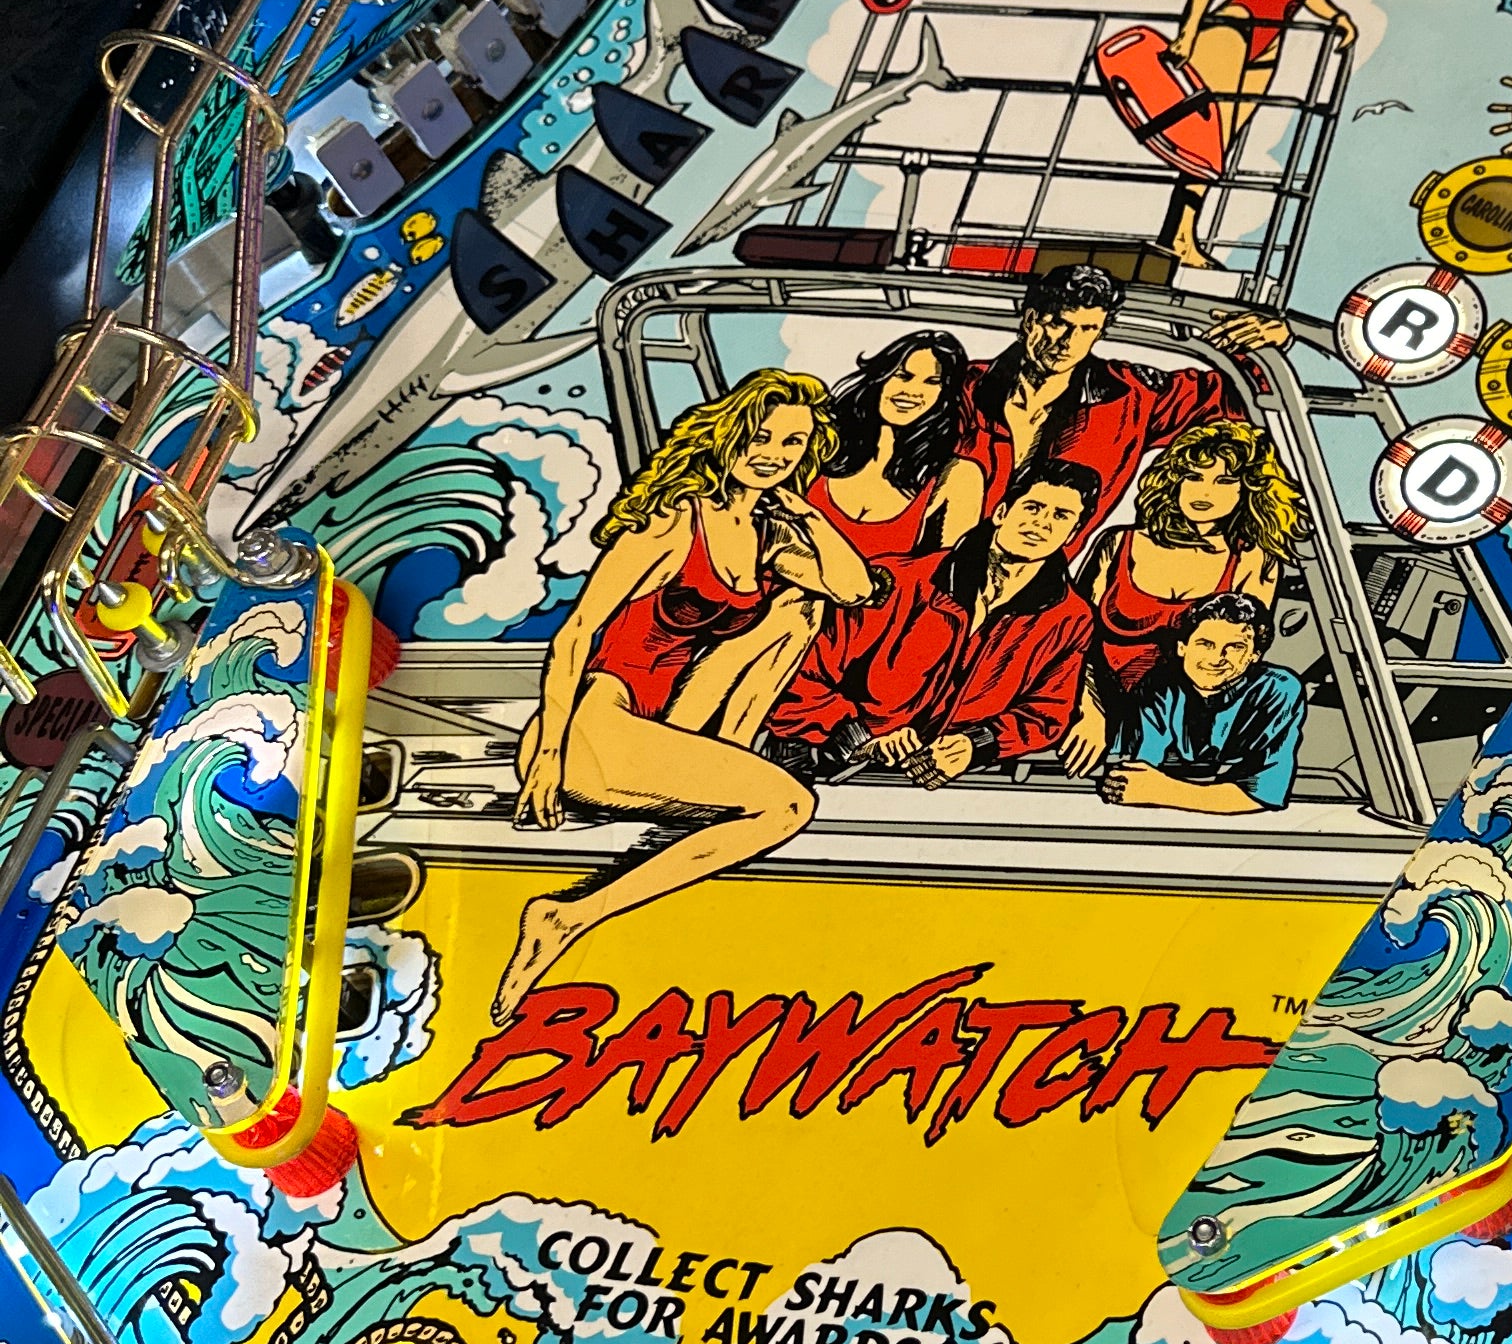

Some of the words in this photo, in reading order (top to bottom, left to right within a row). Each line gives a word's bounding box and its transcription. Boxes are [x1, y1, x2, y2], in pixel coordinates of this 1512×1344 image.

[1379, 298, 1440, 351] R
[1417, 454, 1480, 506] D
[397, 961, 1282, 1147] BAYWATCH
[538, 1228, 772, 1303] COLLECT
[785, 1270, 1000, 1343] SHARKS
[575, 1283, 680, 1342] FOR
